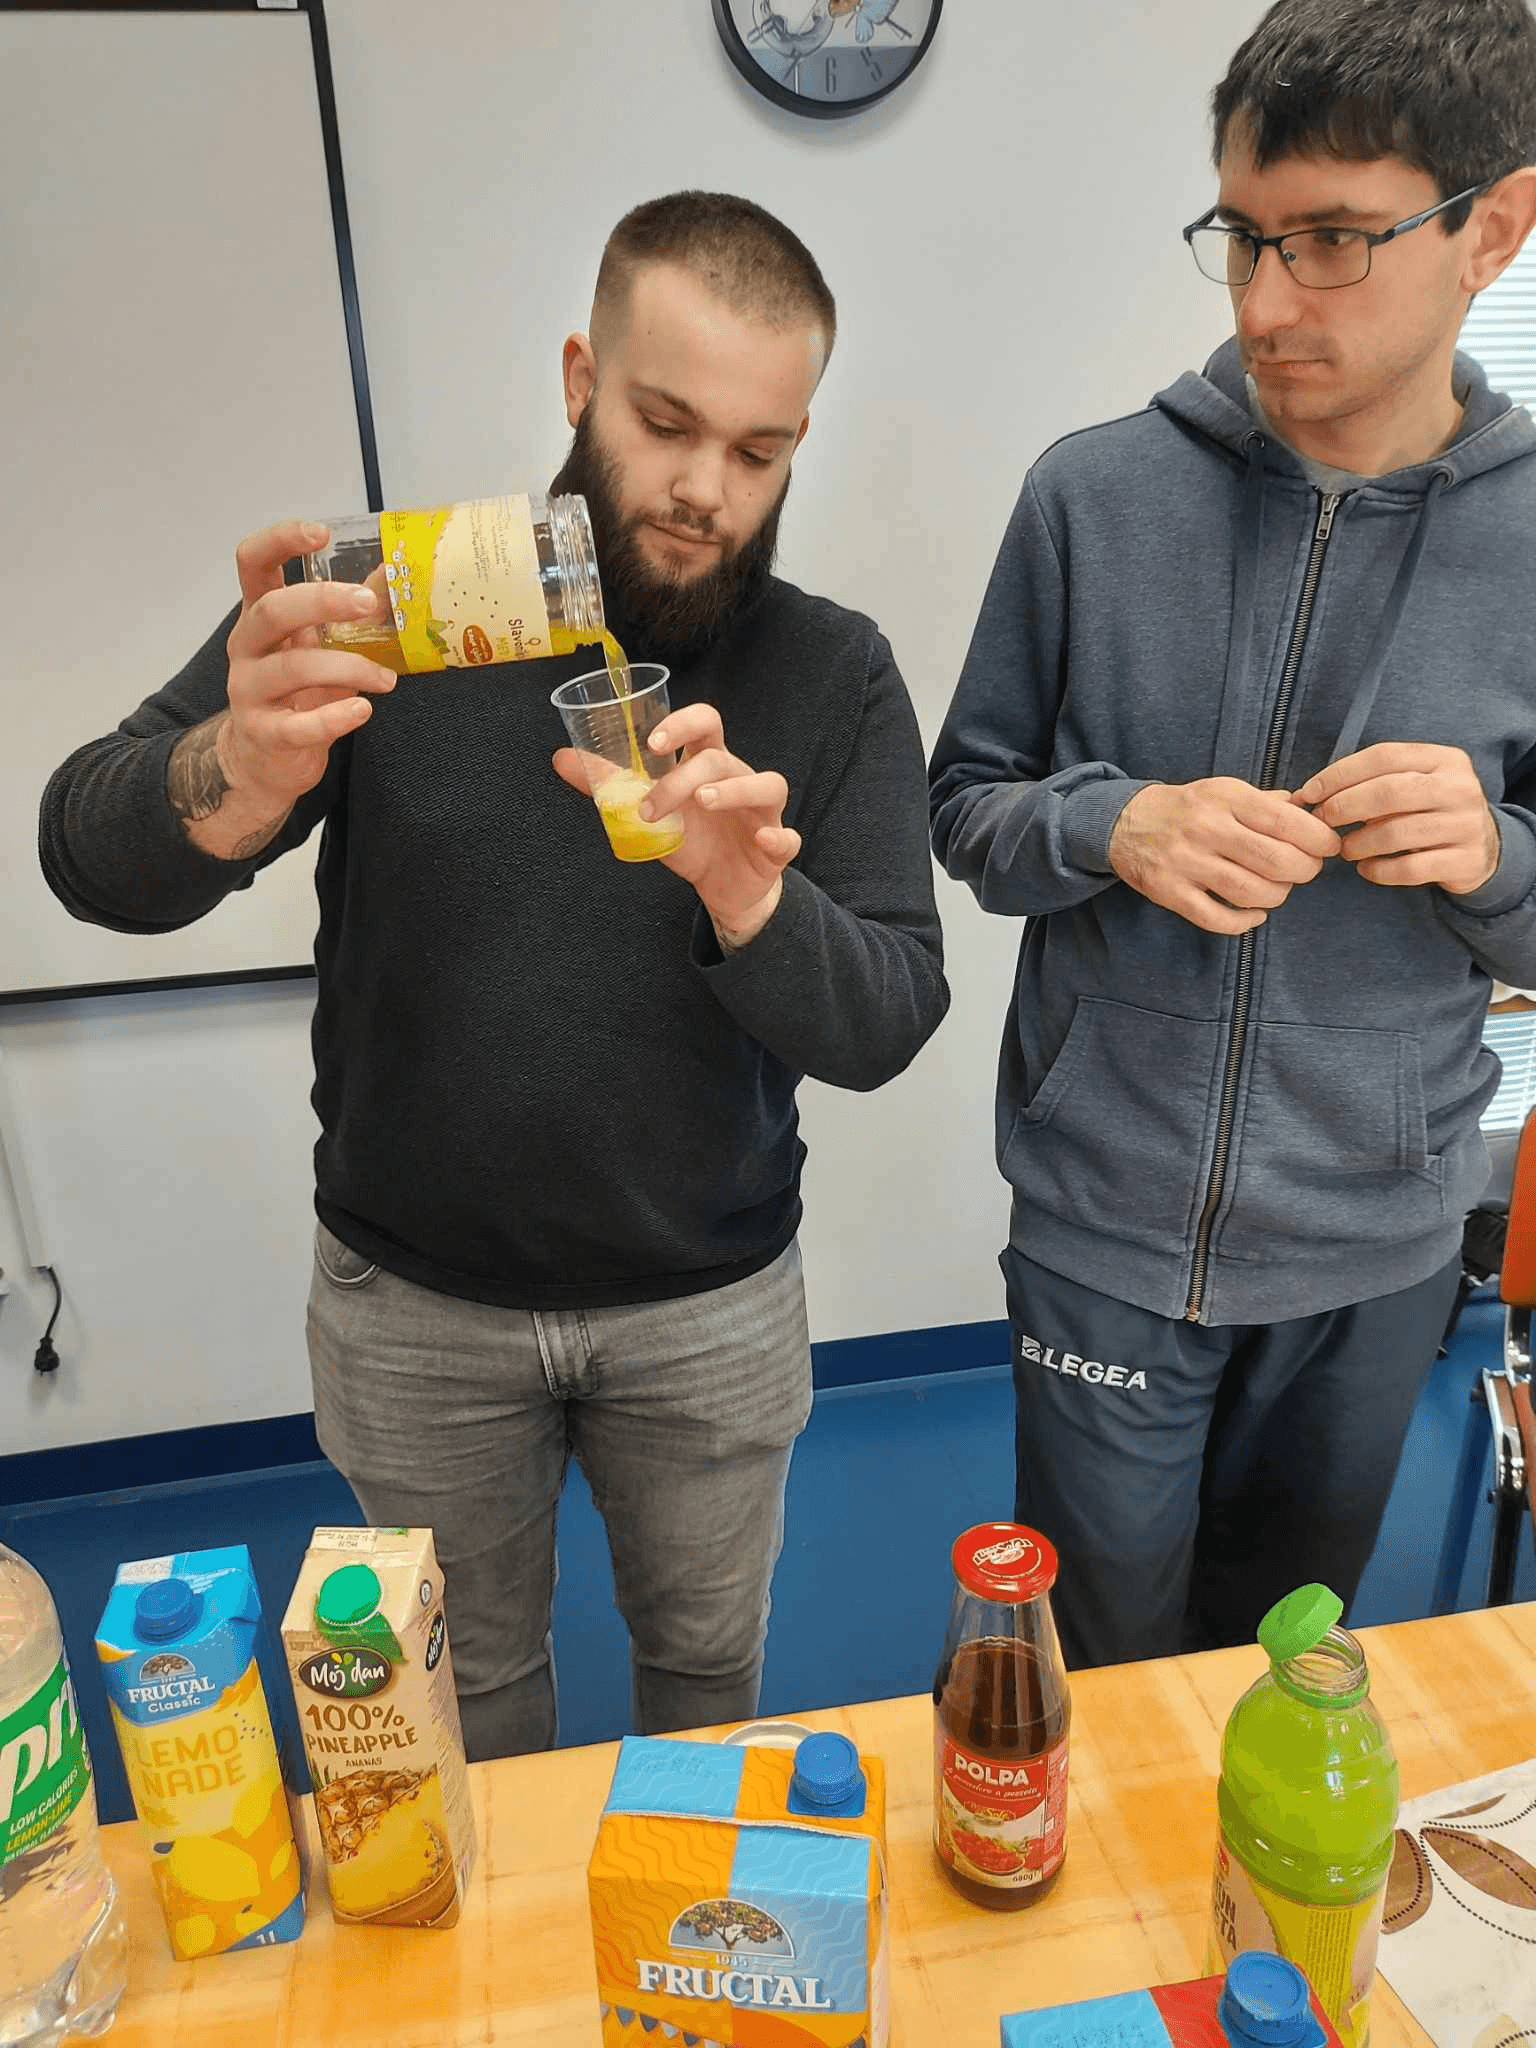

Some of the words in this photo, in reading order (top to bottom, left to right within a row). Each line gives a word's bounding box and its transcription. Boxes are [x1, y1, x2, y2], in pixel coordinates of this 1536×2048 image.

[825, 54, 837, 96] 6
[1041, 1346, 1148, 1391] LEGEA
[127, 1676, 216, 1704] FRUCTAL
[310, 1662, 347, 1692] Moj
[351, 1657, 385, 1687] dan
[148, 1694, 201, 1713] Classic
[305, 1703, 405, 1732] 100%
[131, 1724, 239, 1769] LEMO
[305, 1726, 419, 1755] PINEAPPLE
[141, 1752, 247, 1799] NADE
[345, 1757, 383, 1768] ANANAS
[955, 1752, 1030, 1787] POLPA
[10, 1808, 37, 1836] LOW
[38, 1766, 78, 1816] CALORIES
[6, 1789, 72, 1854] LEMON-LIME
[635, 1957, 832, 2009] FRUCTAL
